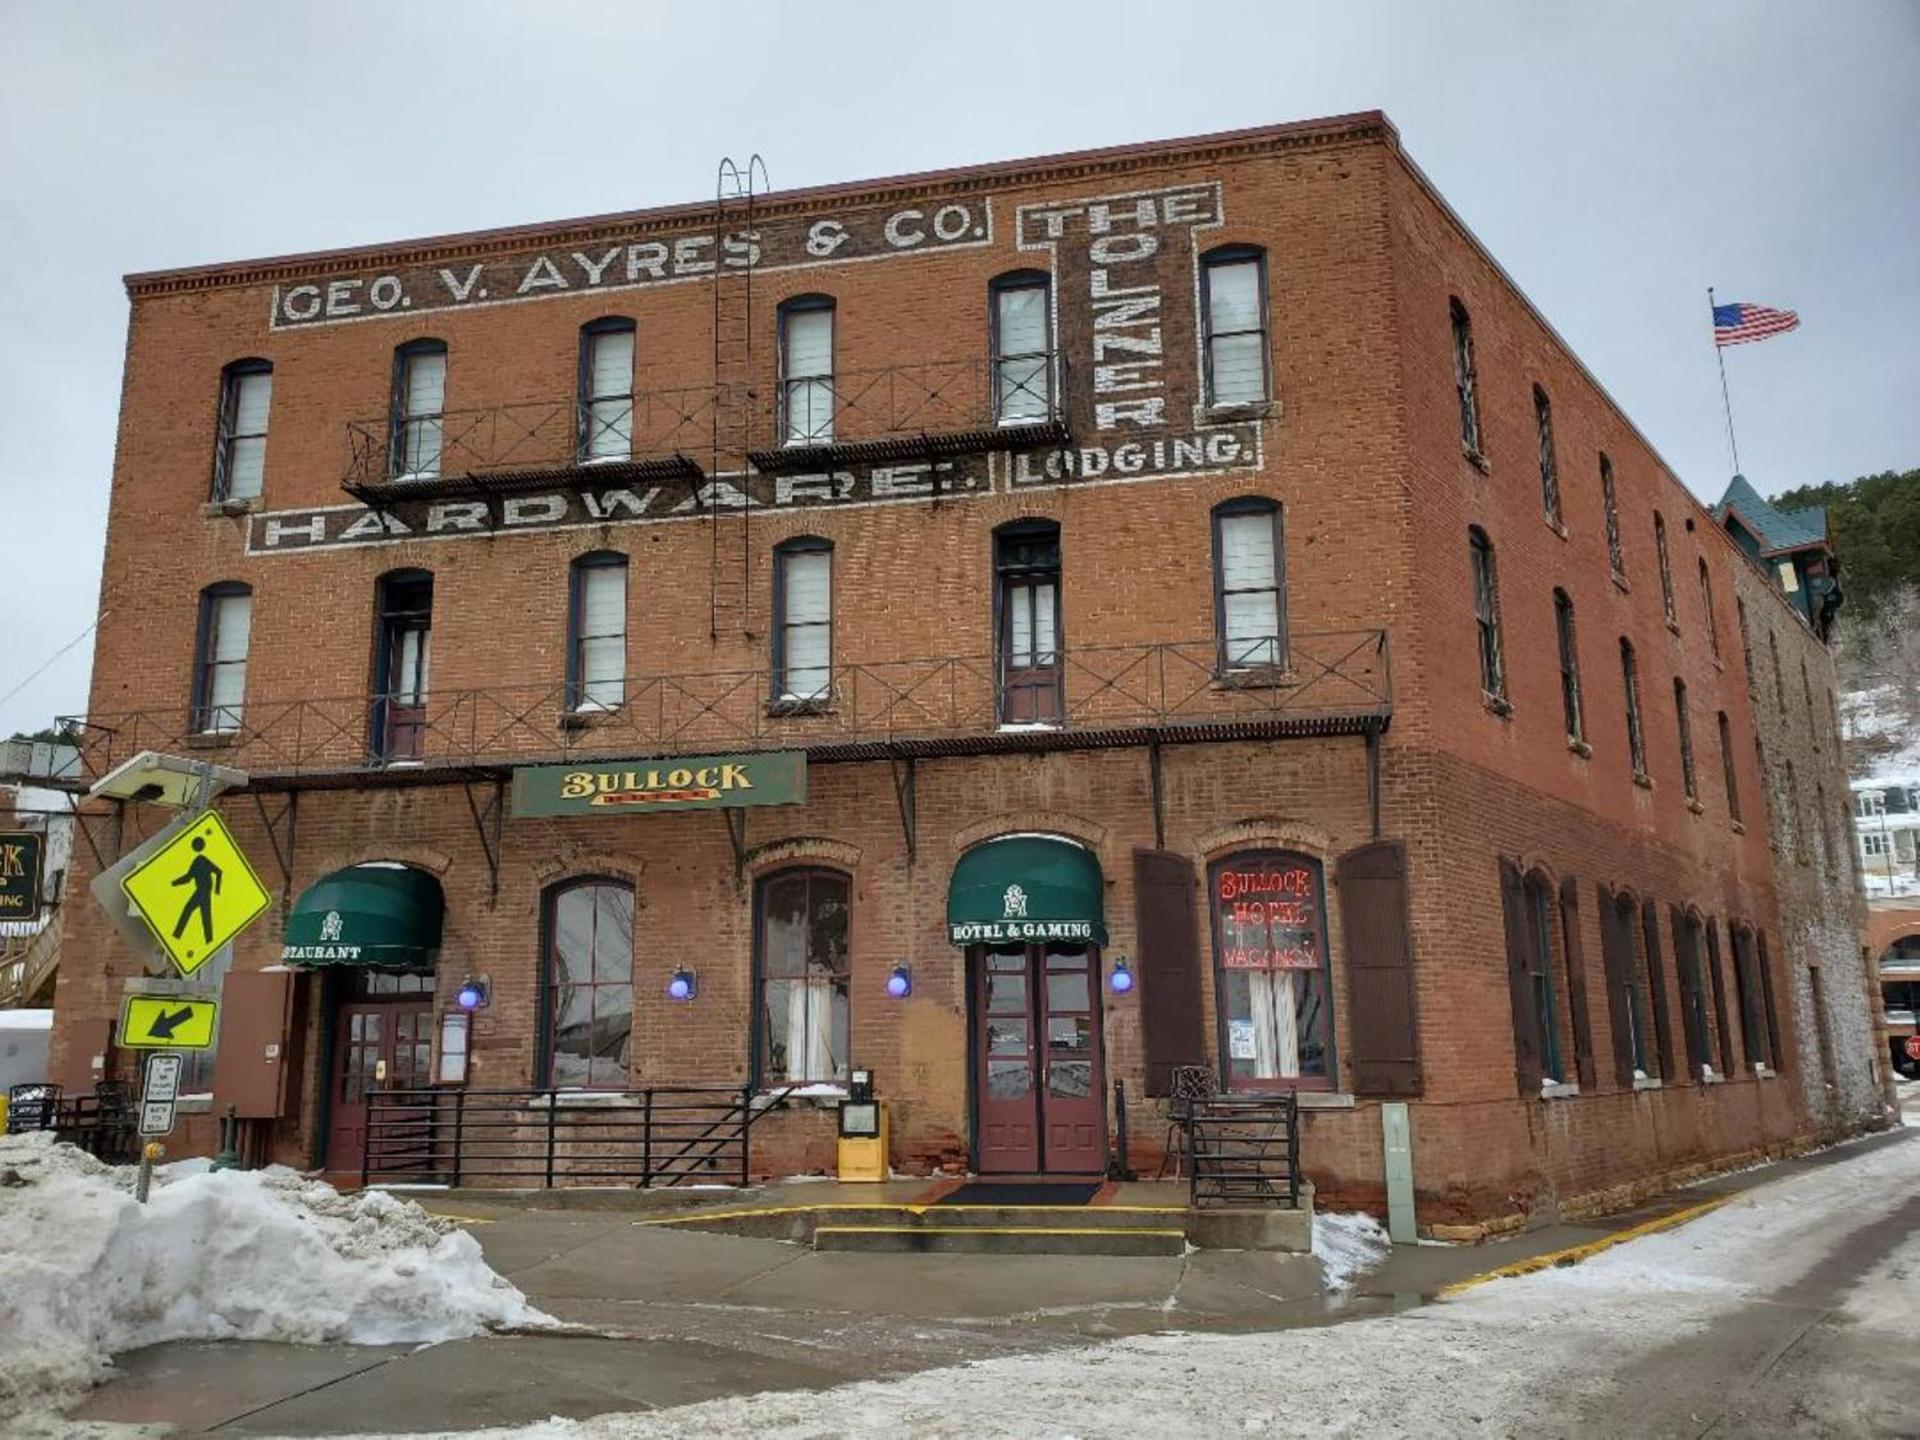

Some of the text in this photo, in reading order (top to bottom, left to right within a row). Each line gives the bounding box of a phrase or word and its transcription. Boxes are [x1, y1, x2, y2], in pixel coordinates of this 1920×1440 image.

[1029, 192, 1213, 237] THE
[283, 204, 984, 320] GEO. V. AYRES & CO.
[560, 763, 754, 799] BULLOCK
[1221, 869, 1311, 899] BULLOCK
[1233, 902, 1308, 924] HOTEL
[953, 922, 1092, 940] HOTEL & GAMING
[1223, 949, 1316, 967] VACANCY
